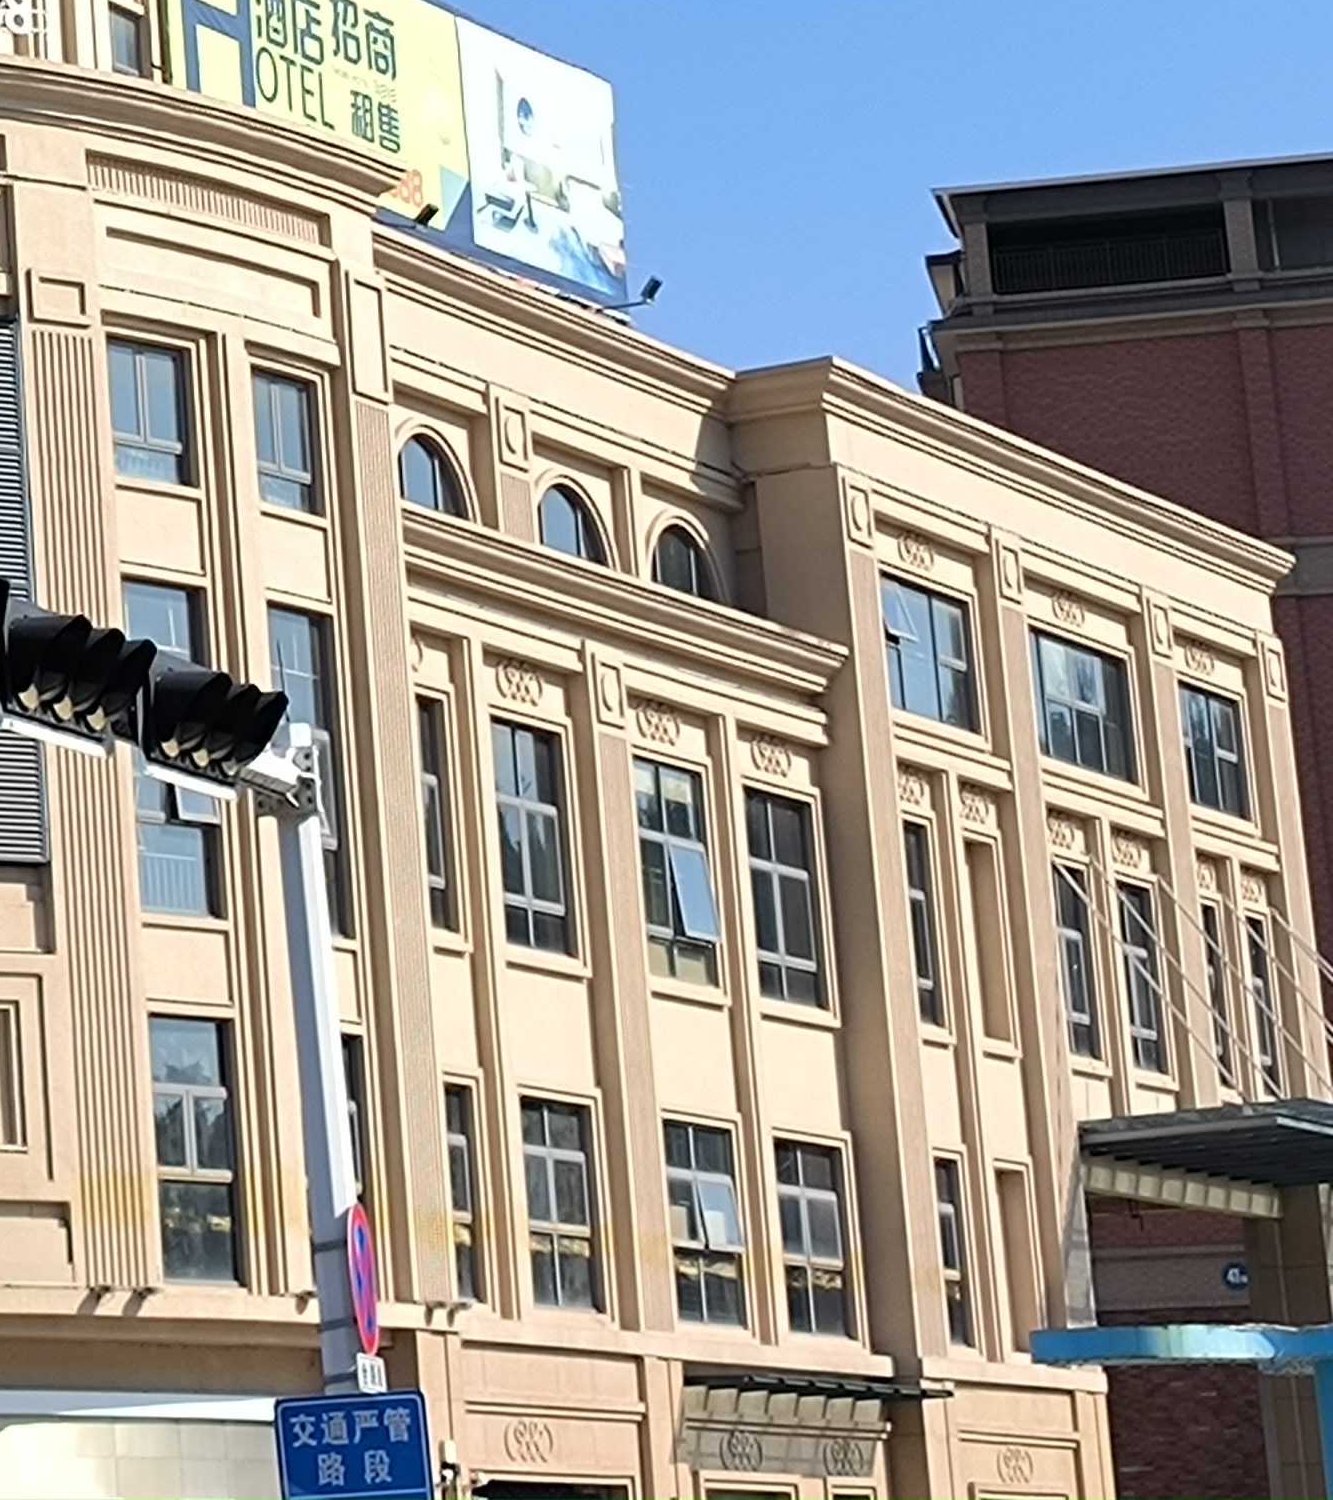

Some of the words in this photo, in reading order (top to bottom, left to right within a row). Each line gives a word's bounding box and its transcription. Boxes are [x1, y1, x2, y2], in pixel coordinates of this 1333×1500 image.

[350, 89, 401, 154] 租售
[289, 1406, 413, 1449] 交通严管
[317, 1449, 393, 1486] 路段
